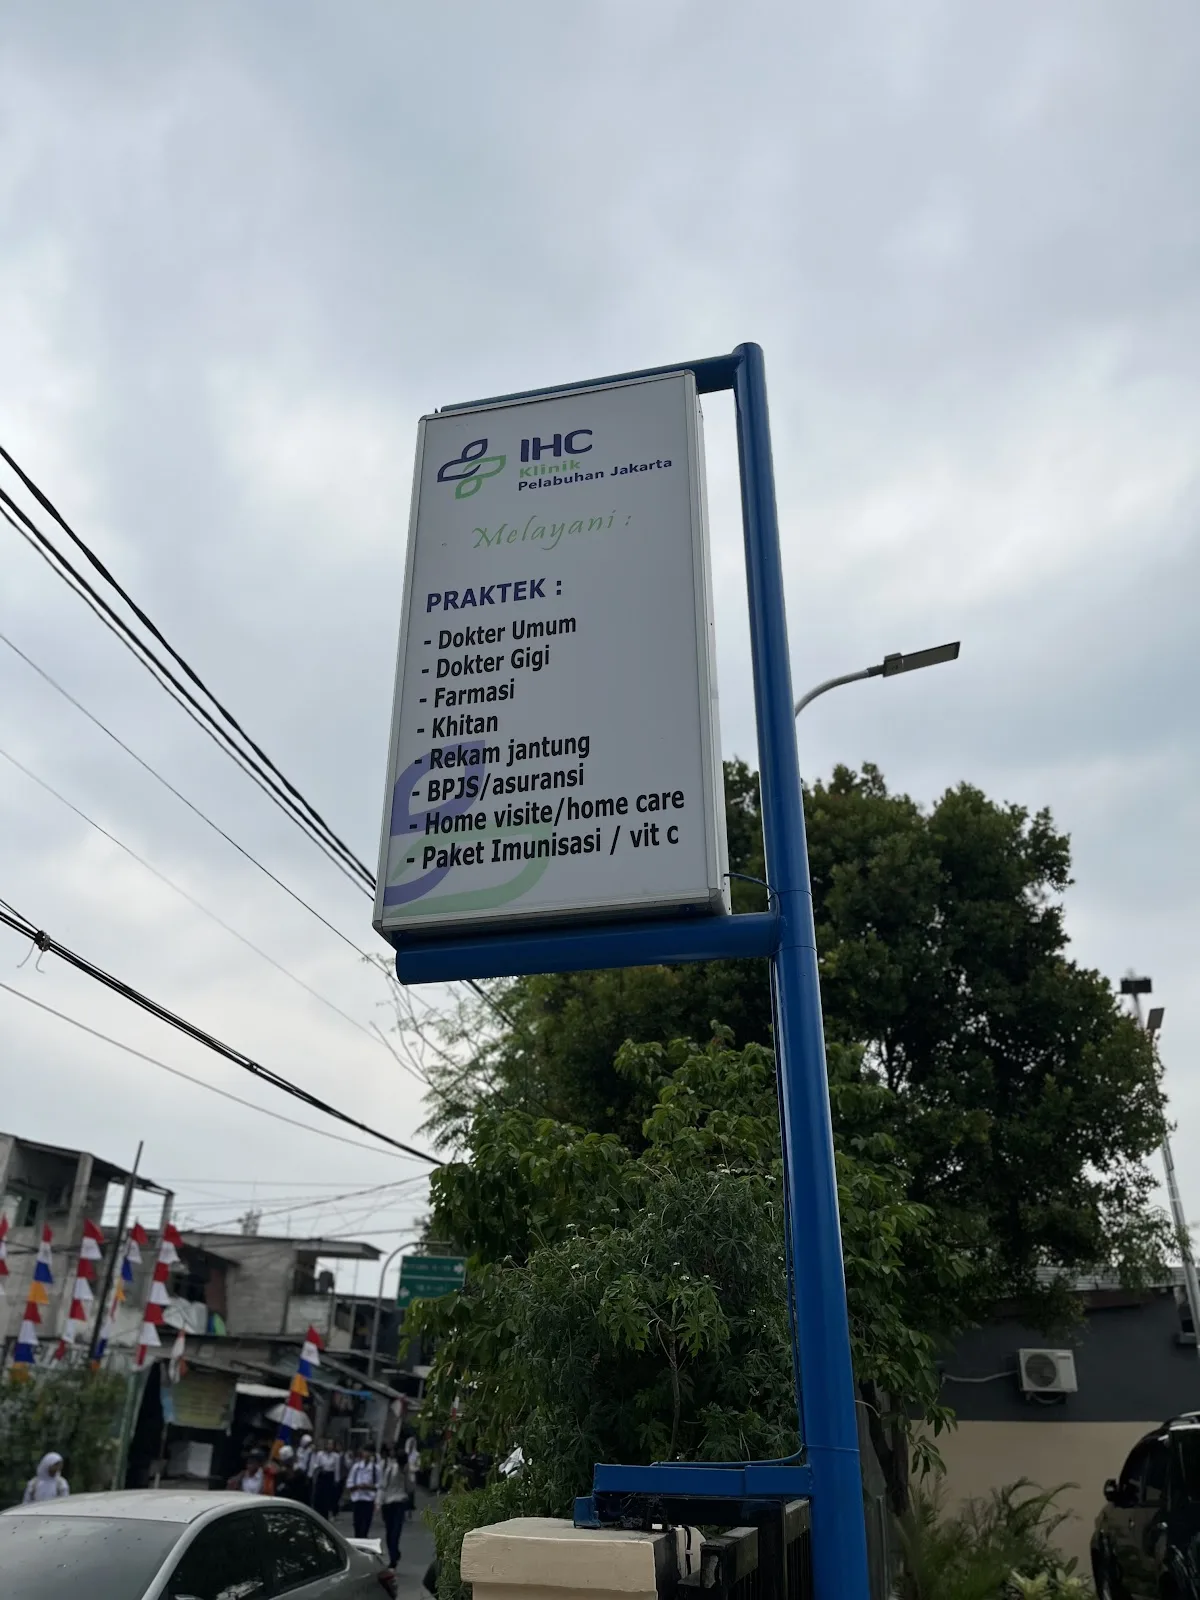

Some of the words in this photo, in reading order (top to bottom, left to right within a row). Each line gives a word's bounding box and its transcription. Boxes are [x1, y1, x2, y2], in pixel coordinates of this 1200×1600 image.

[520, 429, 593, 463] IHC
[518, 469, 605, 491] Pelabuhan
[610, 458, 673, 477] Jakarta
[519, 459, 581, 479] Klinik
[471, 509, 617, 551] Melayani
[426, 578, 546, 613] PRAKTEK
[439, 626, 505, 650] Dokter
[512, 617, 577, 641] Umum
[436, 655, 504, 678] Dokter
[511, 645, 550, 671] Gigi
[434, 679, 515, 708] Farmasi
[432, 715, 498, 739] Khitan
[430, 744, 500, 770] Rekam
[506, 735, 590, 767] jantung
[427, 763, 584, 802] BPJS/asuransi
[425, 812, 487, 835] Home
[494, 798, 628, 828] visite/home
[635, 790, 685, 812] care
[422, 841, 484, 869] Paket
[491, 828, 601, 863] Imunisasi
[630, 822, 659, 848] vit
